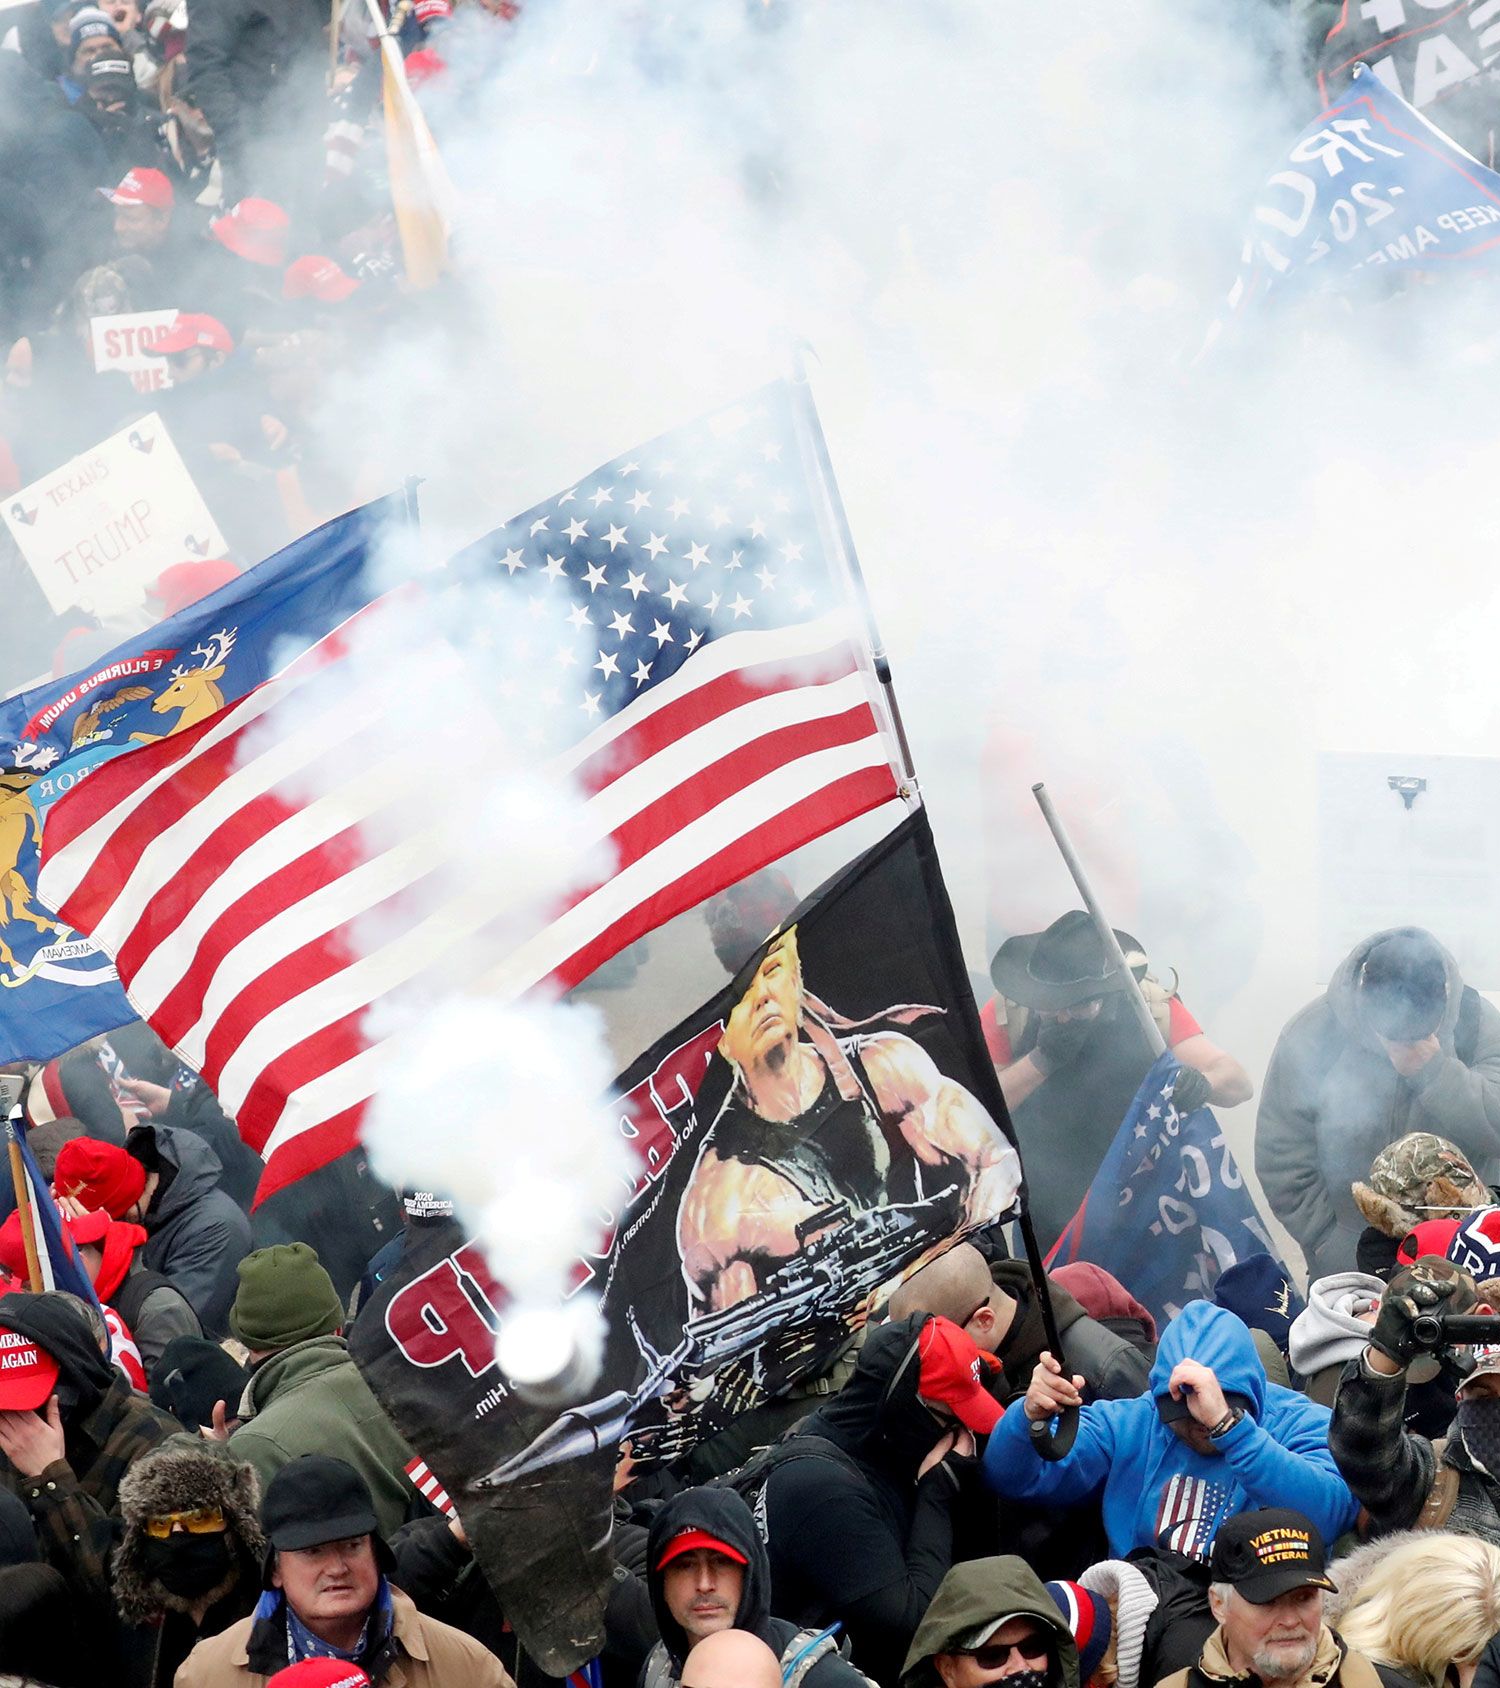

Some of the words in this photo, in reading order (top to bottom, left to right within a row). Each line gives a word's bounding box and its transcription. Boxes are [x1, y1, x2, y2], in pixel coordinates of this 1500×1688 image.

[45, 458, 112, 508] TEXANS
[54, 499, 152, 586] TRUMP
[414, 1191, 434, 1202] 2020
[416, 1200, 454, 1210] AMERICA
[1, 1349, 38, 1370] AGAIN
[1249, 1528, 1310, 1549] VIETNAM
[1260, 1551, 1309, 1566] VETERAN
